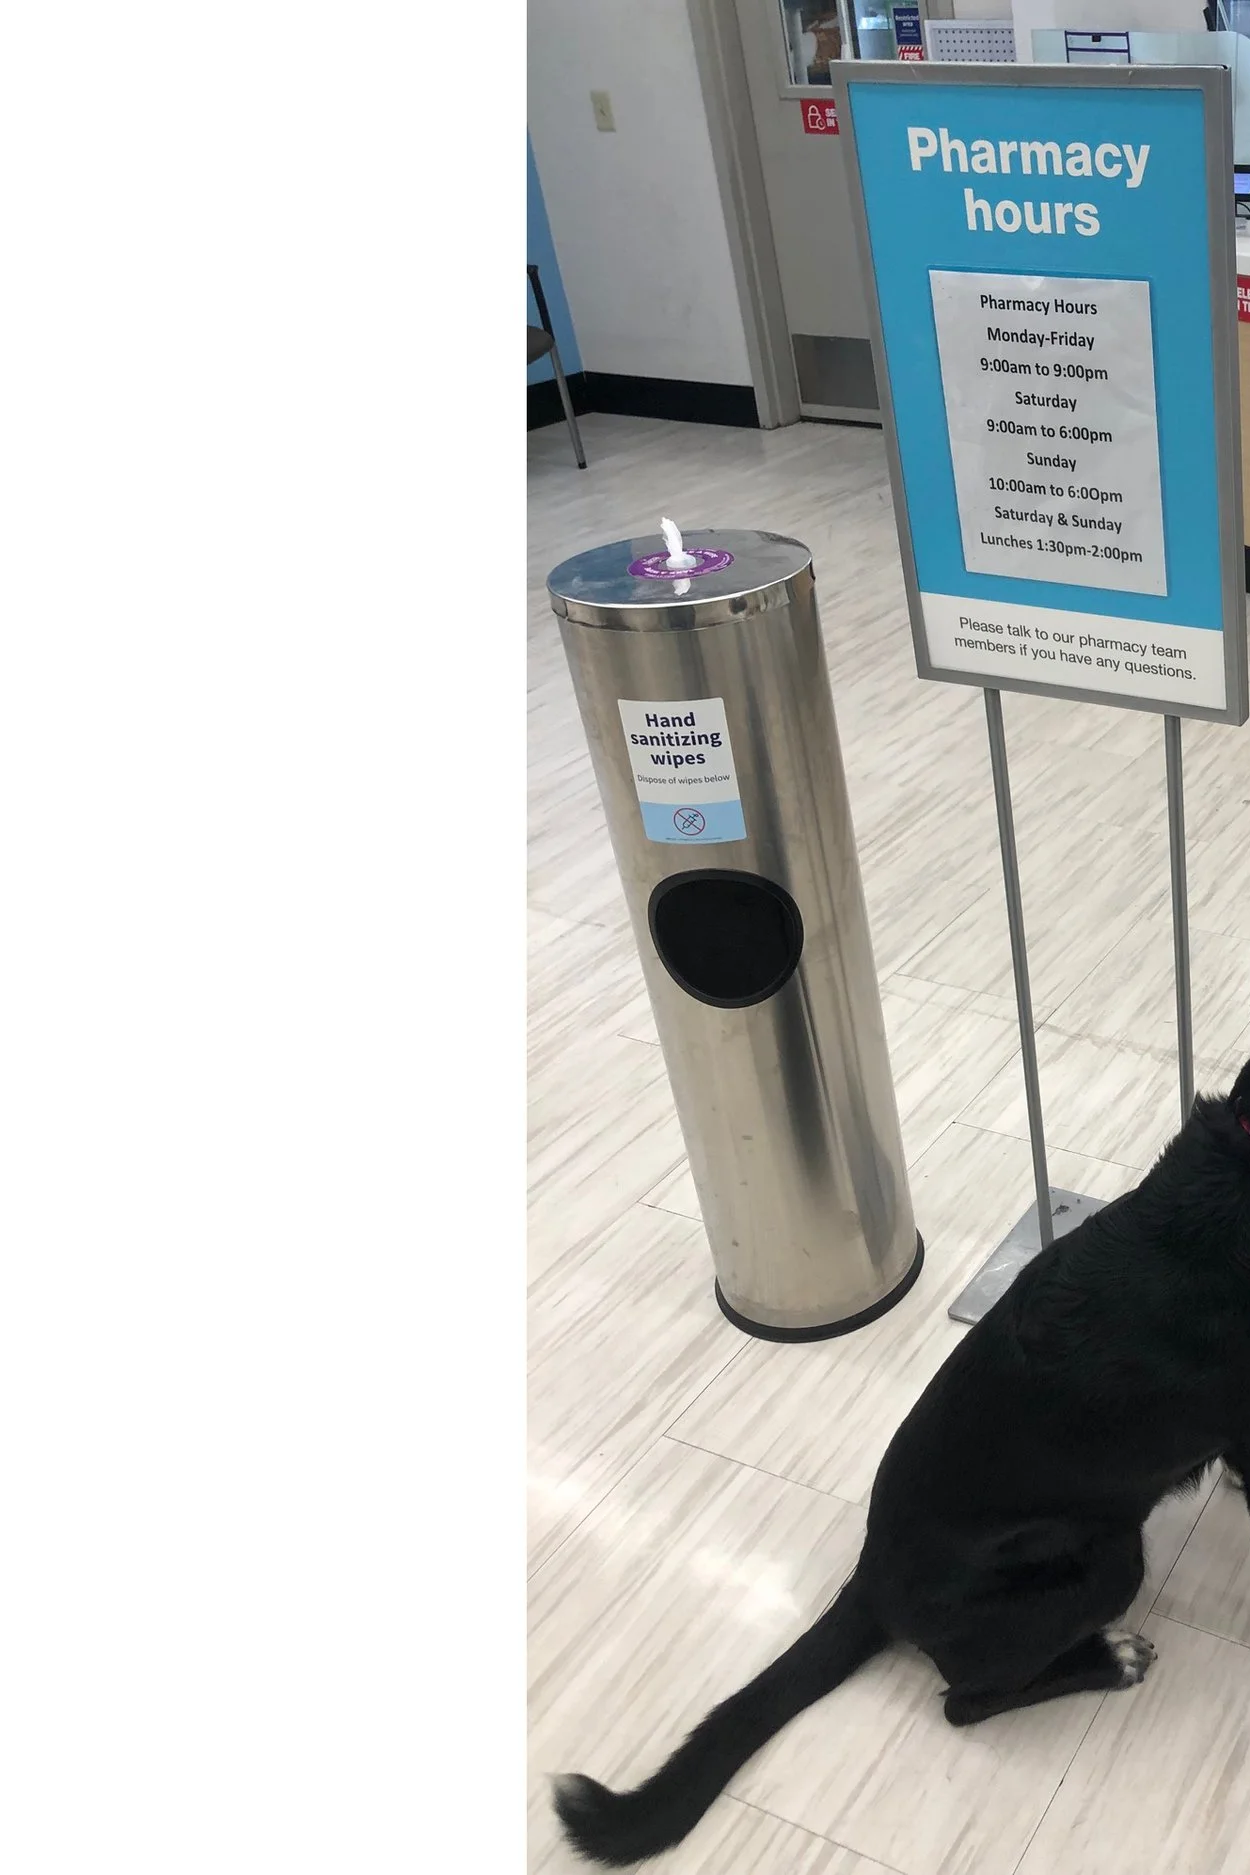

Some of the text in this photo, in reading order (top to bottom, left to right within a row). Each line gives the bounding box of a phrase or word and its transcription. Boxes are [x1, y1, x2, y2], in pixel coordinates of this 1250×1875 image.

[907, 127, 1150, 188] Pharmacy
[964, 188, 1100, 236] hours
[980, 294, 1098, 316] Pharmacy Hours
[987, 327, 1095, 351] Monday-Friday
[980, 357, 1108, 382] 9:00am to 9:00pm
[1015, 391, 1077, 412] Saturday
[987, 418, 1112, 444] 9:00am to 6:00pm
[1027, 452, 1076, 472] Sunday
[989, 477, 1046, 495] 10:00am
[1050, 484, 1064, 497] to
[994, 506, 1122, 534] Saturday & Sunday
[980, 532, 1143, 563] Lunches 1:30pm-2:00pm
[959, 616, 1187, 660] Please talk to our pharmacy team
[954, 635, 1197, 681] members if you have any questions.
[645, 712, 696, 728] Hand
[630, 731, 722, 748] sanitizing
[650, 750, 706, 769] wipes
[637, 774, 731, 786] Dispose of wipes below
